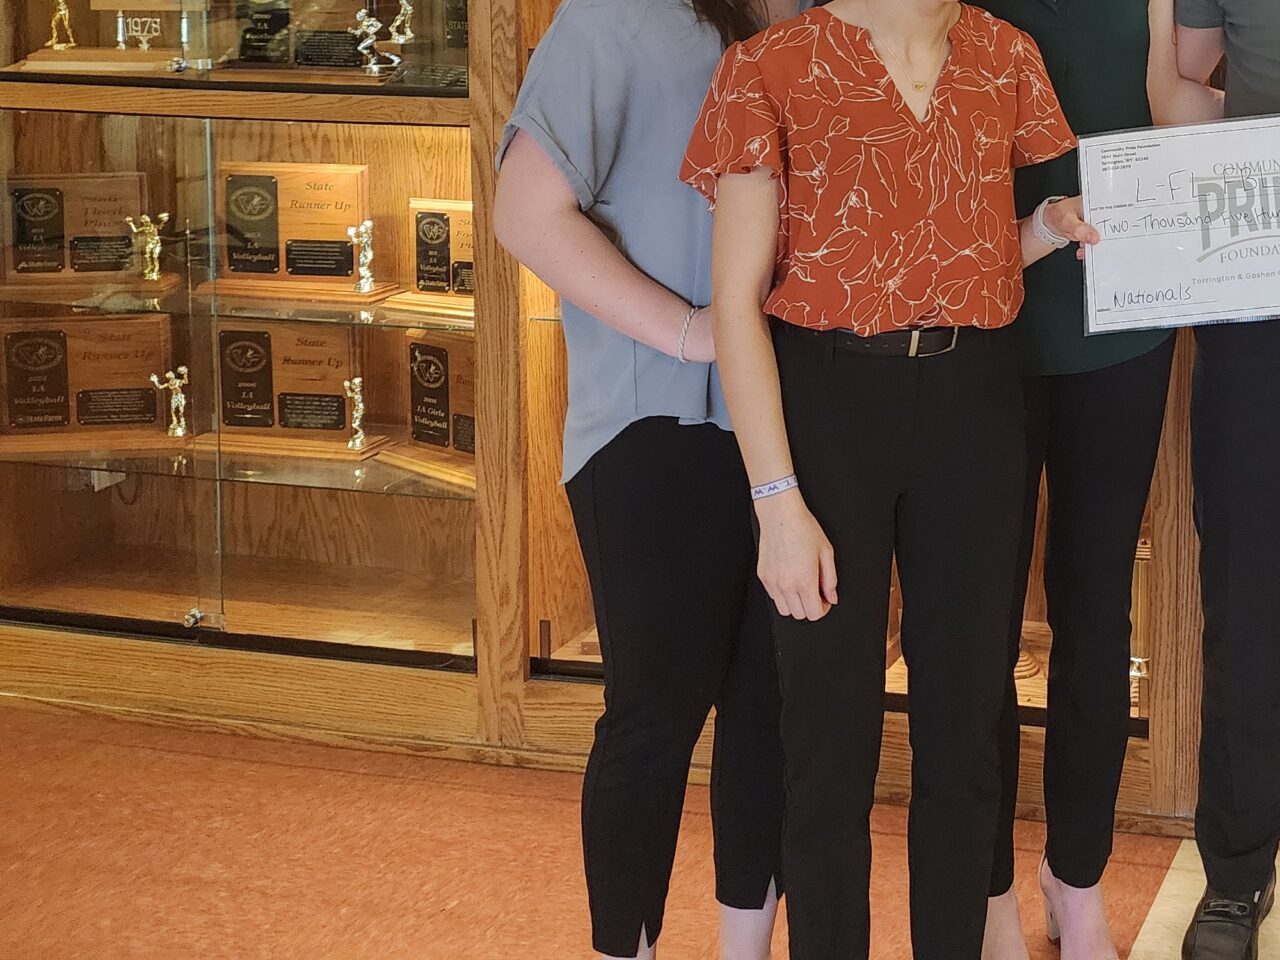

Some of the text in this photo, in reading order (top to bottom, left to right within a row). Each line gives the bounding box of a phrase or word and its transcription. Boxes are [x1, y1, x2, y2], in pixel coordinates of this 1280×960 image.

[126, 17, 161, 36] 1978
[305, 181, 335, 191] State
[290, 199, 351, 213] Runner Up
[1221, 210, 1253, 227] Five
[232, 252, 275, 263] Volleyball
[1192, 273, 1236, 285] Torrington
[1237, 271, 1243, 280] &
[1245, 269, 1276, 280] Goshen
[1114, 283, 1192, 308] Nationals
[295, 338, 326, 348] State
[281, 355, 344, 369] Runner Up
[226, 401, 270, 411] Volleyball
[428, 407, 445, 417] Girls
[415, 415, 448, 429] Volleyball
